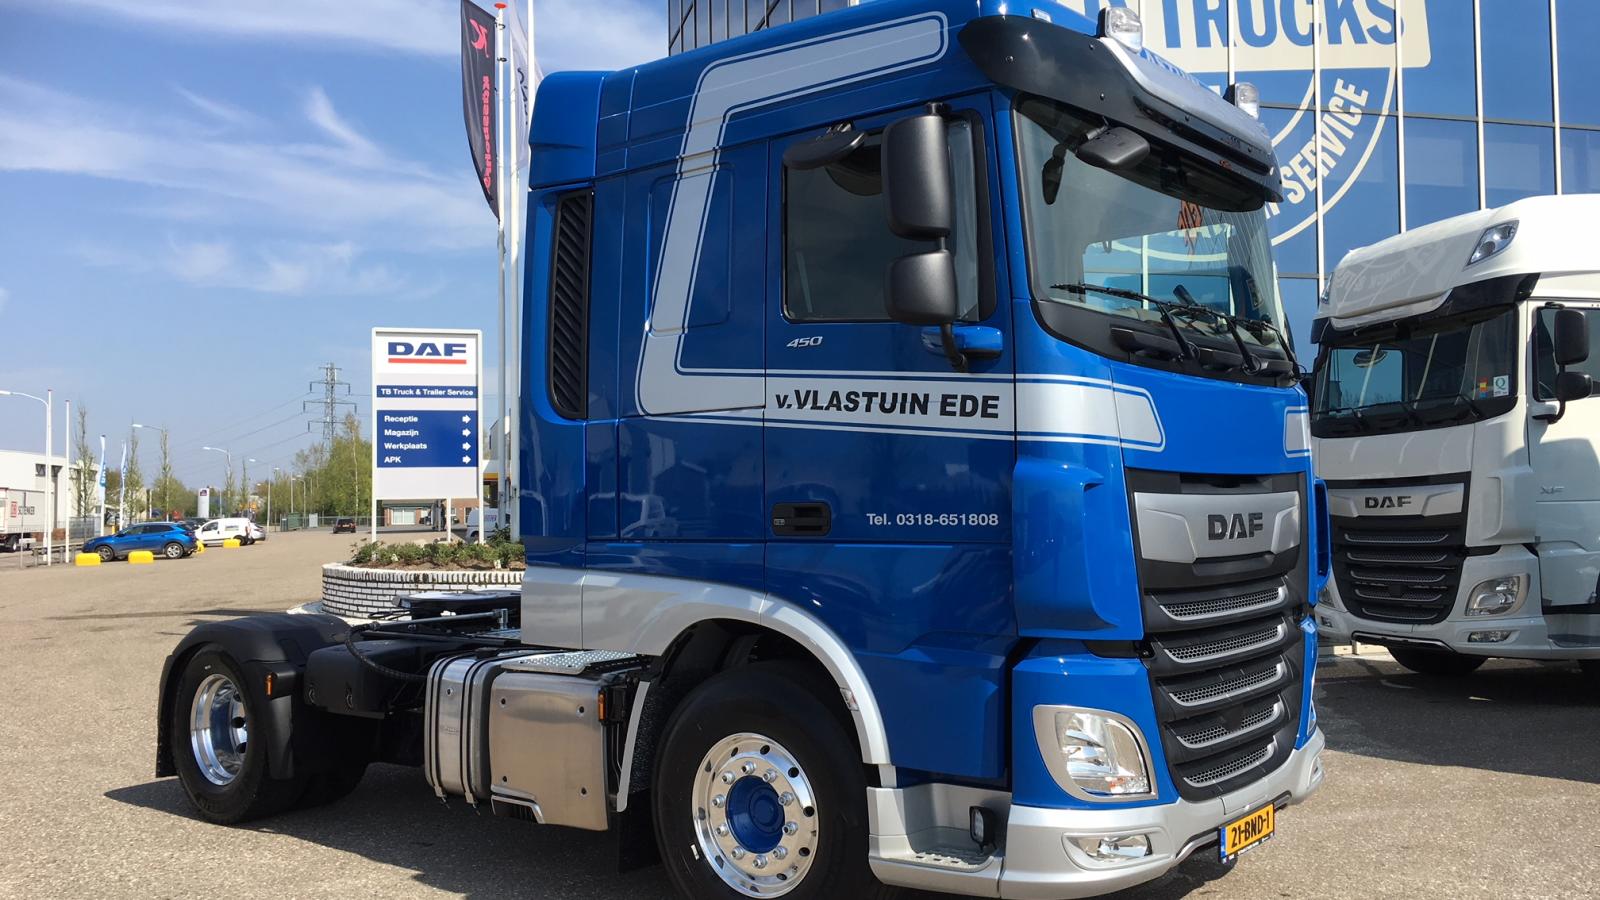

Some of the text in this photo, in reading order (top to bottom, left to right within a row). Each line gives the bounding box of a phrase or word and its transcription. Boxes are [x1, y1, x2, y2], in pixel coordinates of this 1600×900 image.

[1162, 0, 1405, 48] TRUCKS
[1280, 78, 1369, 204] SERVICE
[786, 335, 823, 348] 450
[388, 342, 467, 356] DAF
[422, 388, 446, 396] Trailer
[775, 389, 1000, 419] v.VLASTUIN EDE
[384, 415, 418, 423] Receptie
[384, 429, 419, 437] Magazijn
[1364, 495, 1412, 509] DAF
[866, 513, 999, 526] Tel. 0318-651808
[1207, 512, 1264, 541] DAF
[1231, 810, 1270, 849] 21-BND-1
